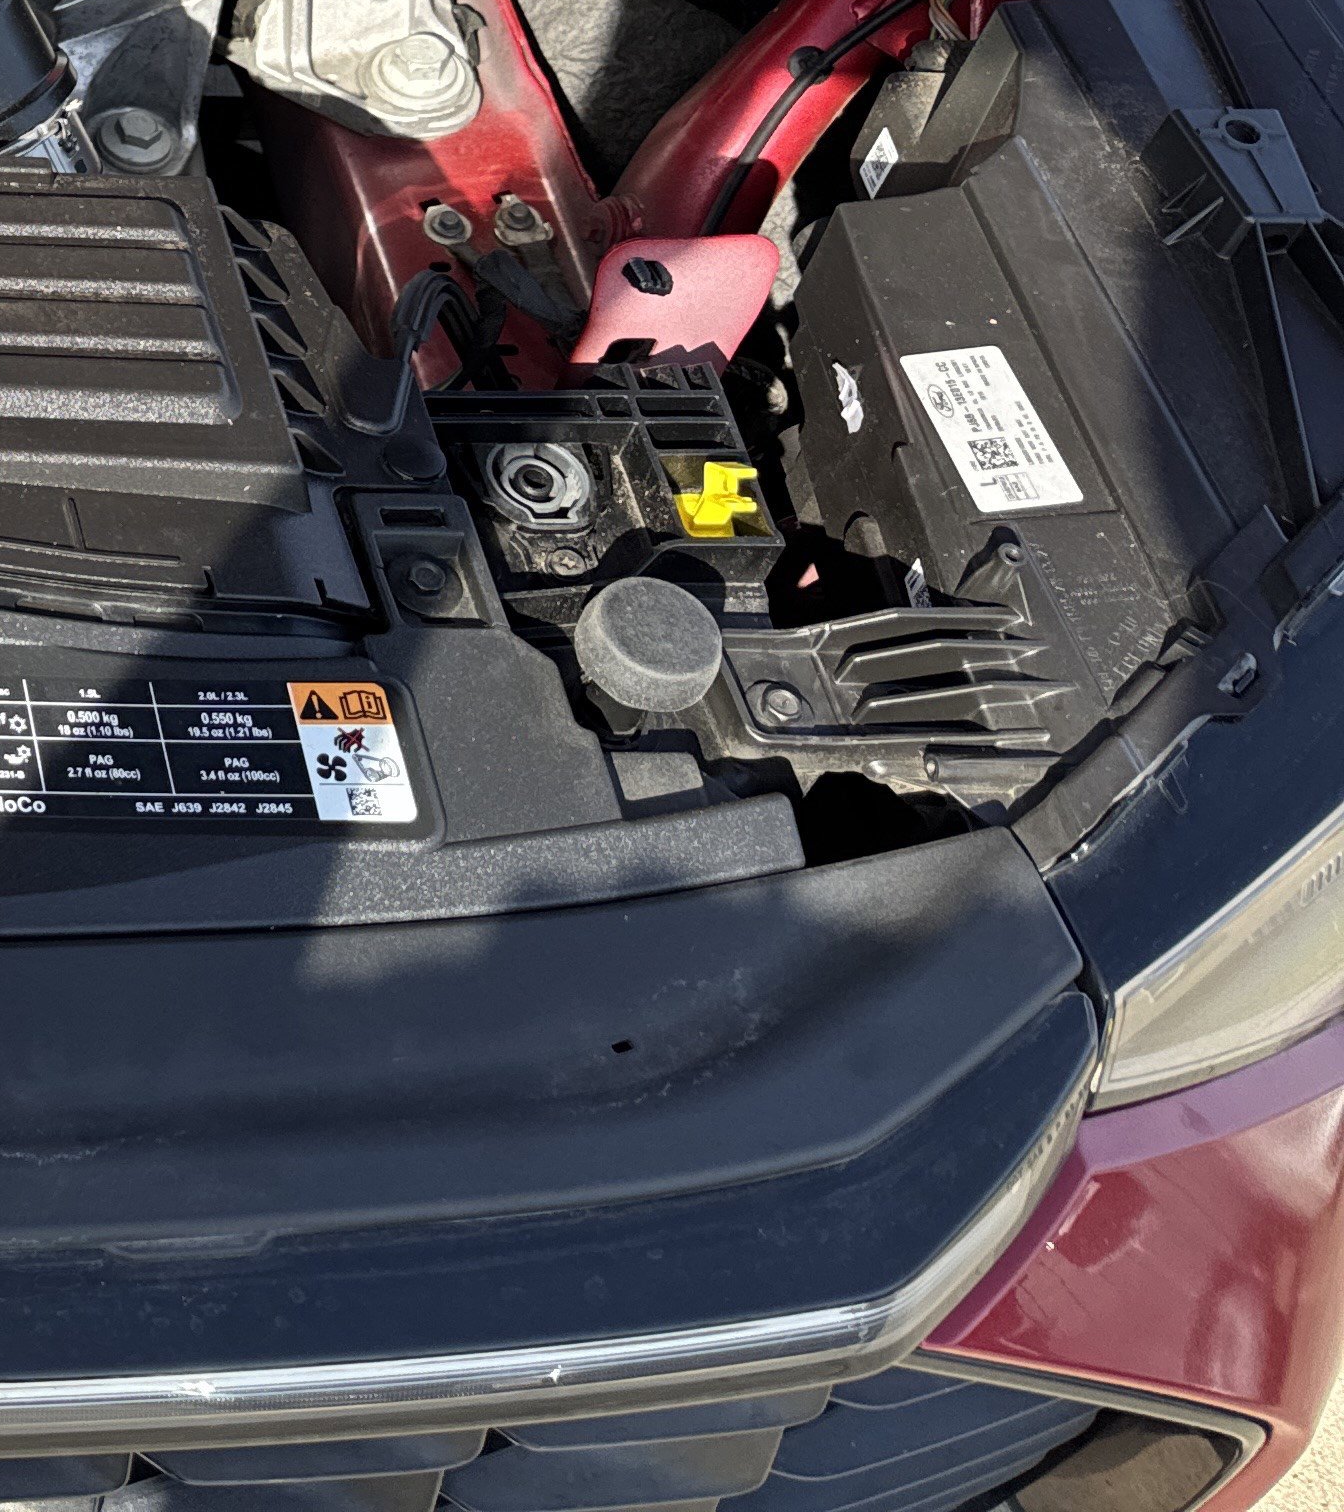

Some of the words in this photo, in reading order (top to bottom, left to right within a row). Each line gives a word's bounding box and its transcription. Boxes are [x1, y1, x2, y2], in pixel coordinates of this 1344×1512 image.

[66, 710, 101, 724] 0.500
[101, 711, 119, 726] kg
[200, 711, 234, 725] 0.550
[235, 712, 253, 727] kg
[72, 726, 86, 736] oz
[87, 724, 113, 737] (1.10
[113, 725, 134, 738] lbs)
[187, 726, 210, 737] 19.5
[210, 728, 225, 738] oz
[225, 726, 250, 739] (1.21
[250, 726, 273, 739] lbs)
[88, 754, 115, 766] PAG
[223, 757, 250, 768] PAG
[66, 766, 83, 778] 2.7
[93, 769, 108, 779] oz
[199, 769, 217, 781] 3.4
[227, 772, 241, 781] oz
[241, 770, 281, 784] (100cc)
[135, 801, 165, 813] SAE
[171, 801, 203, 814] J639
[208, 801, 247, 814] J2842
[255, 802, 293, 815] J2845
